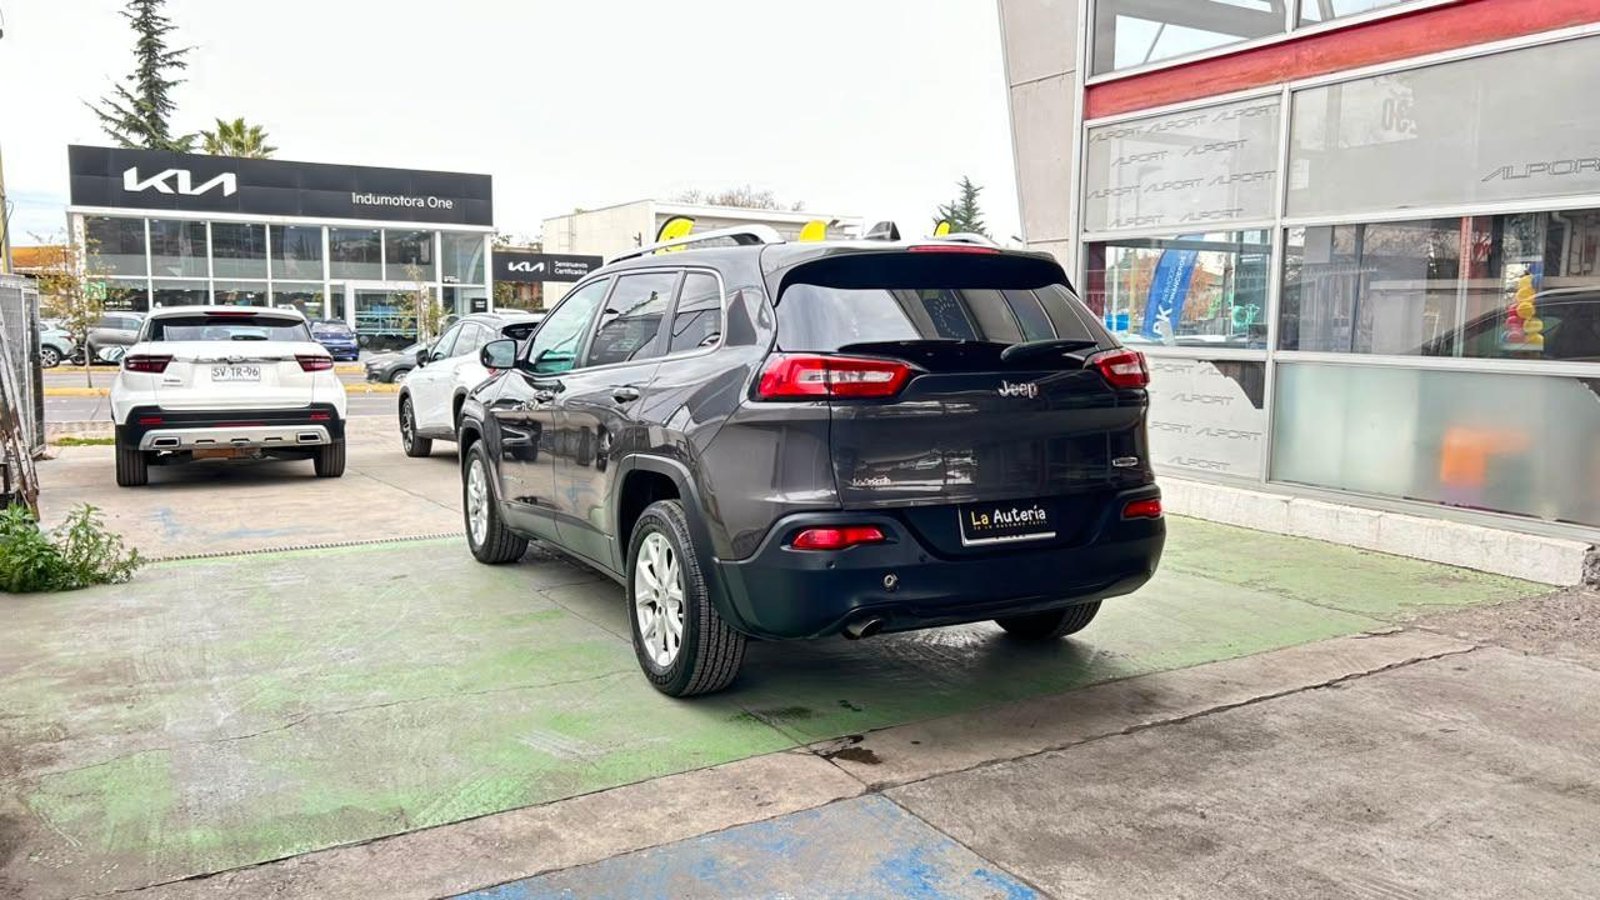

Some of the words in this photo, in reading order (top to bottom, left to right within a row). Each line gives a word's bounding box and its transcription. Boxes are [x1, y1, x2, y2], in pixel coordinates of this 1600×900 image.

[1480, 157, 1600, 183] ALPOR
[351, 191, 425, 208] Indumotora
[427, 196, 453, 210] One
[1150, 363, 1194, 374] PORT
[998, 379, 1038, 399] Jeep
[1150, 421, 1192, 433] PORT
[970, 511, 989, 526] La
[993, 504, 1046, 524] Autería
